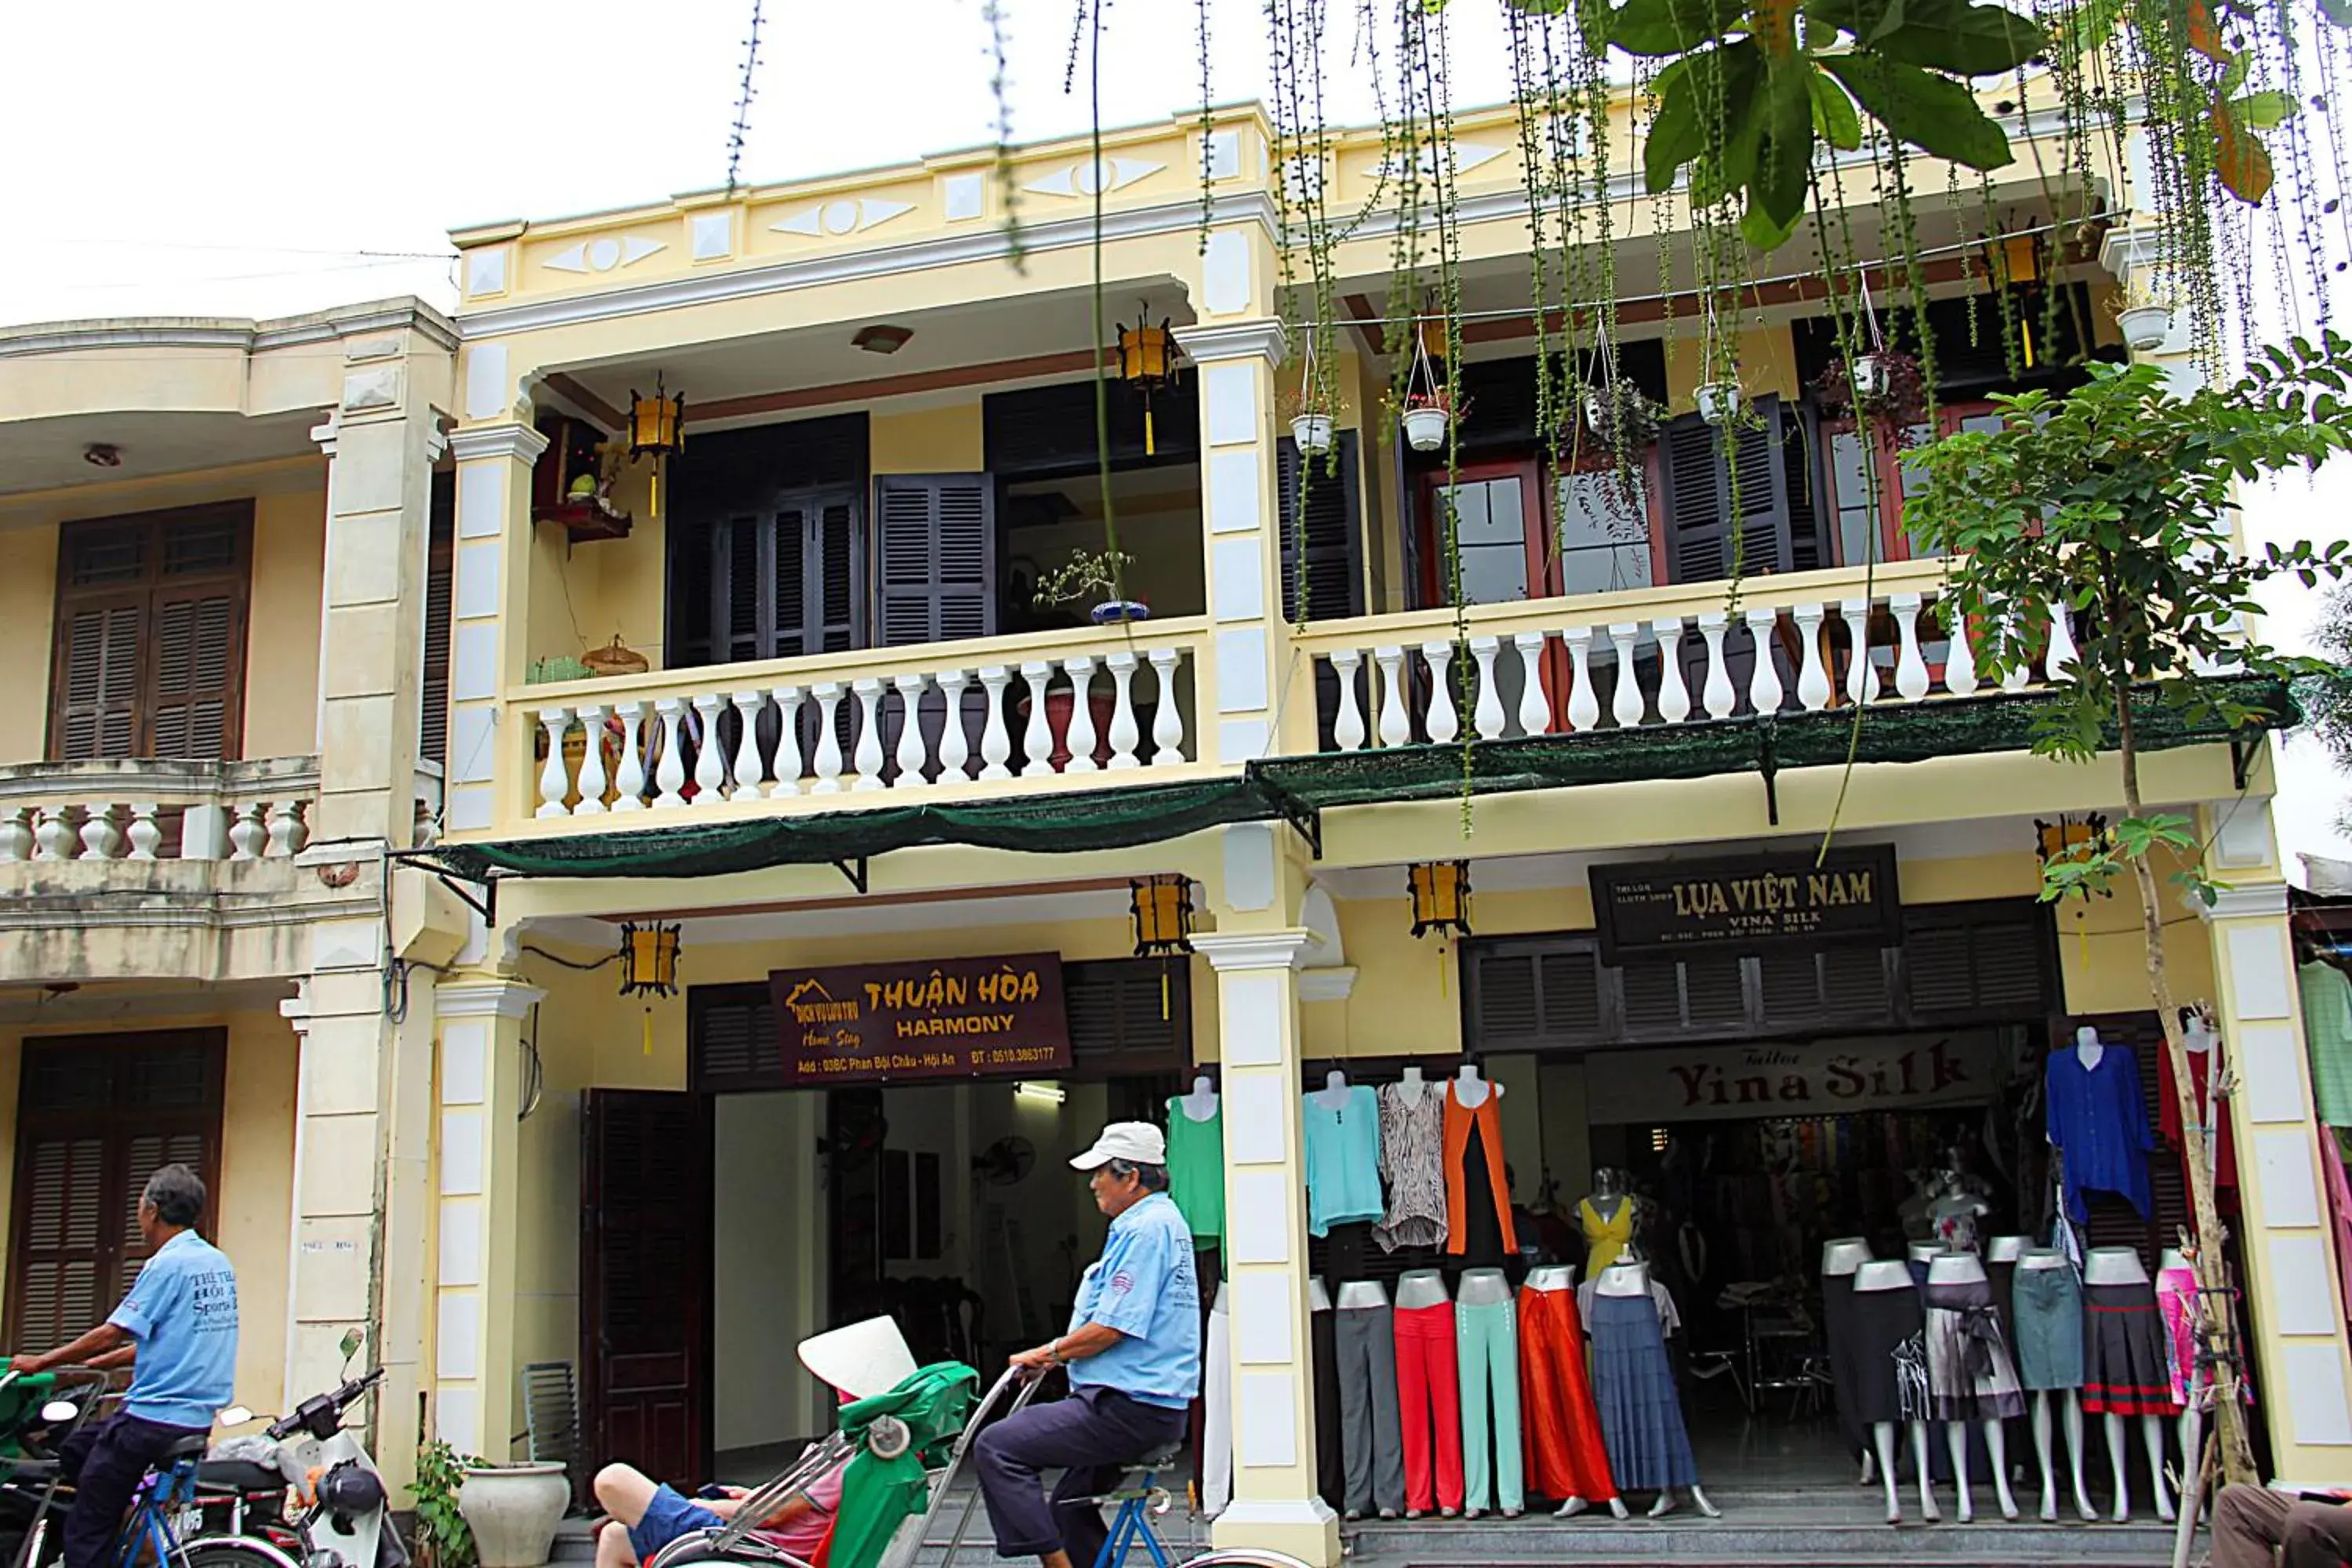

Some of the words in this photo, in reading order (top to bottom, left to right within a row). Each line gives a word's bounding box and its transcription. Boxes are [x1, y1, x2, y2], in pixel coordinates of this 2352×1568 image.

[1671, 882, 1728, 920] LỤA
[1731, 872, 1798, 916] VIỆT
[1807, 872, 1871, 908] NAM
[1729, 915, 1775, 927] VINA
[1783, 911, 1821, 924] SILK
[865, 969, 967, 1014] THUẬN
[978, 964, 1040, 1004] HÒA
[897, 1014, 1015, 1039] HARMONY
[849, 1057, 873, 1070] Phan
[942, 1052, 956, 1066] An
[1825, 1038, 1970, 1098] Silk
